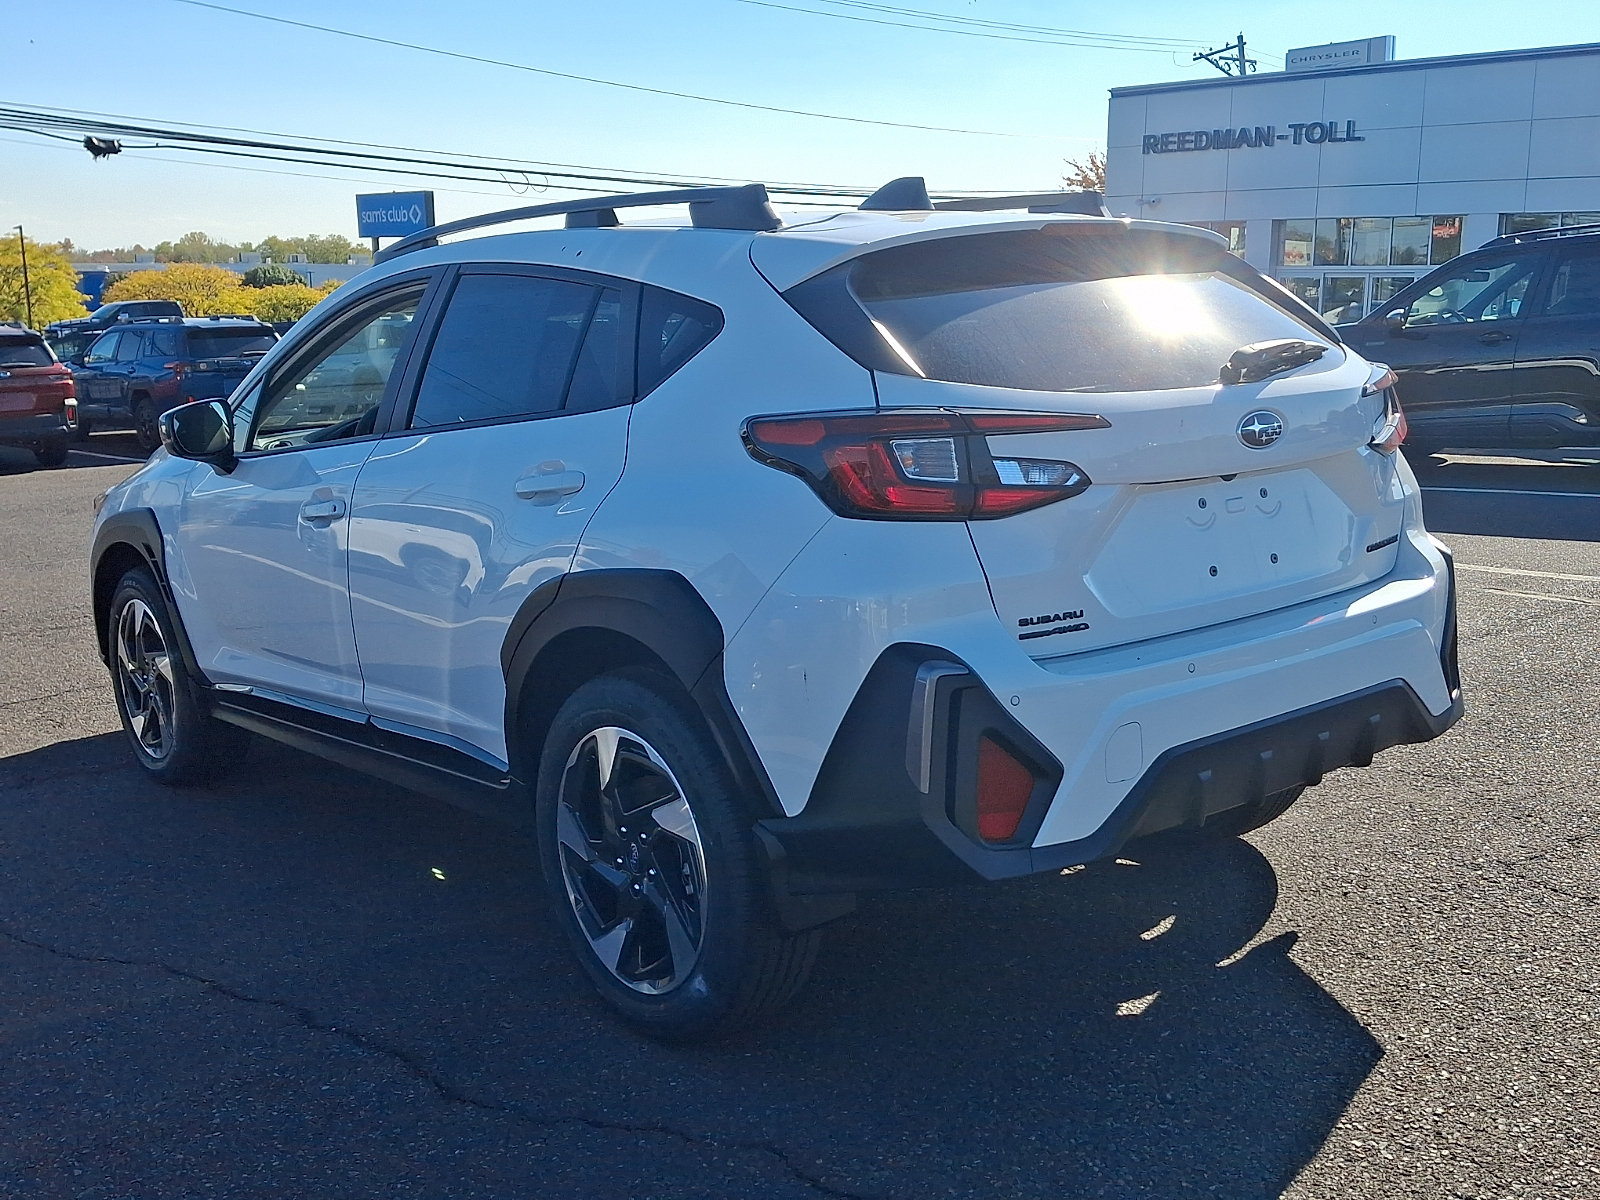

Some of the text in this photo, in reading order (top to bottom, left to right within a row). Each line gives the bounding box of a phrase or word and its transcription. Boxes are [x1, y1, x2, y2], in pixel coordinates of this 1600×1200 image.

[1291, 49, 1360, 64] CHRYSLER
[1142, 119, 1365, 155] REEDMAN-TOLL
[361, 205, 408, 223] sam's club
[1018, 609, 1084, 627] SUBARU
